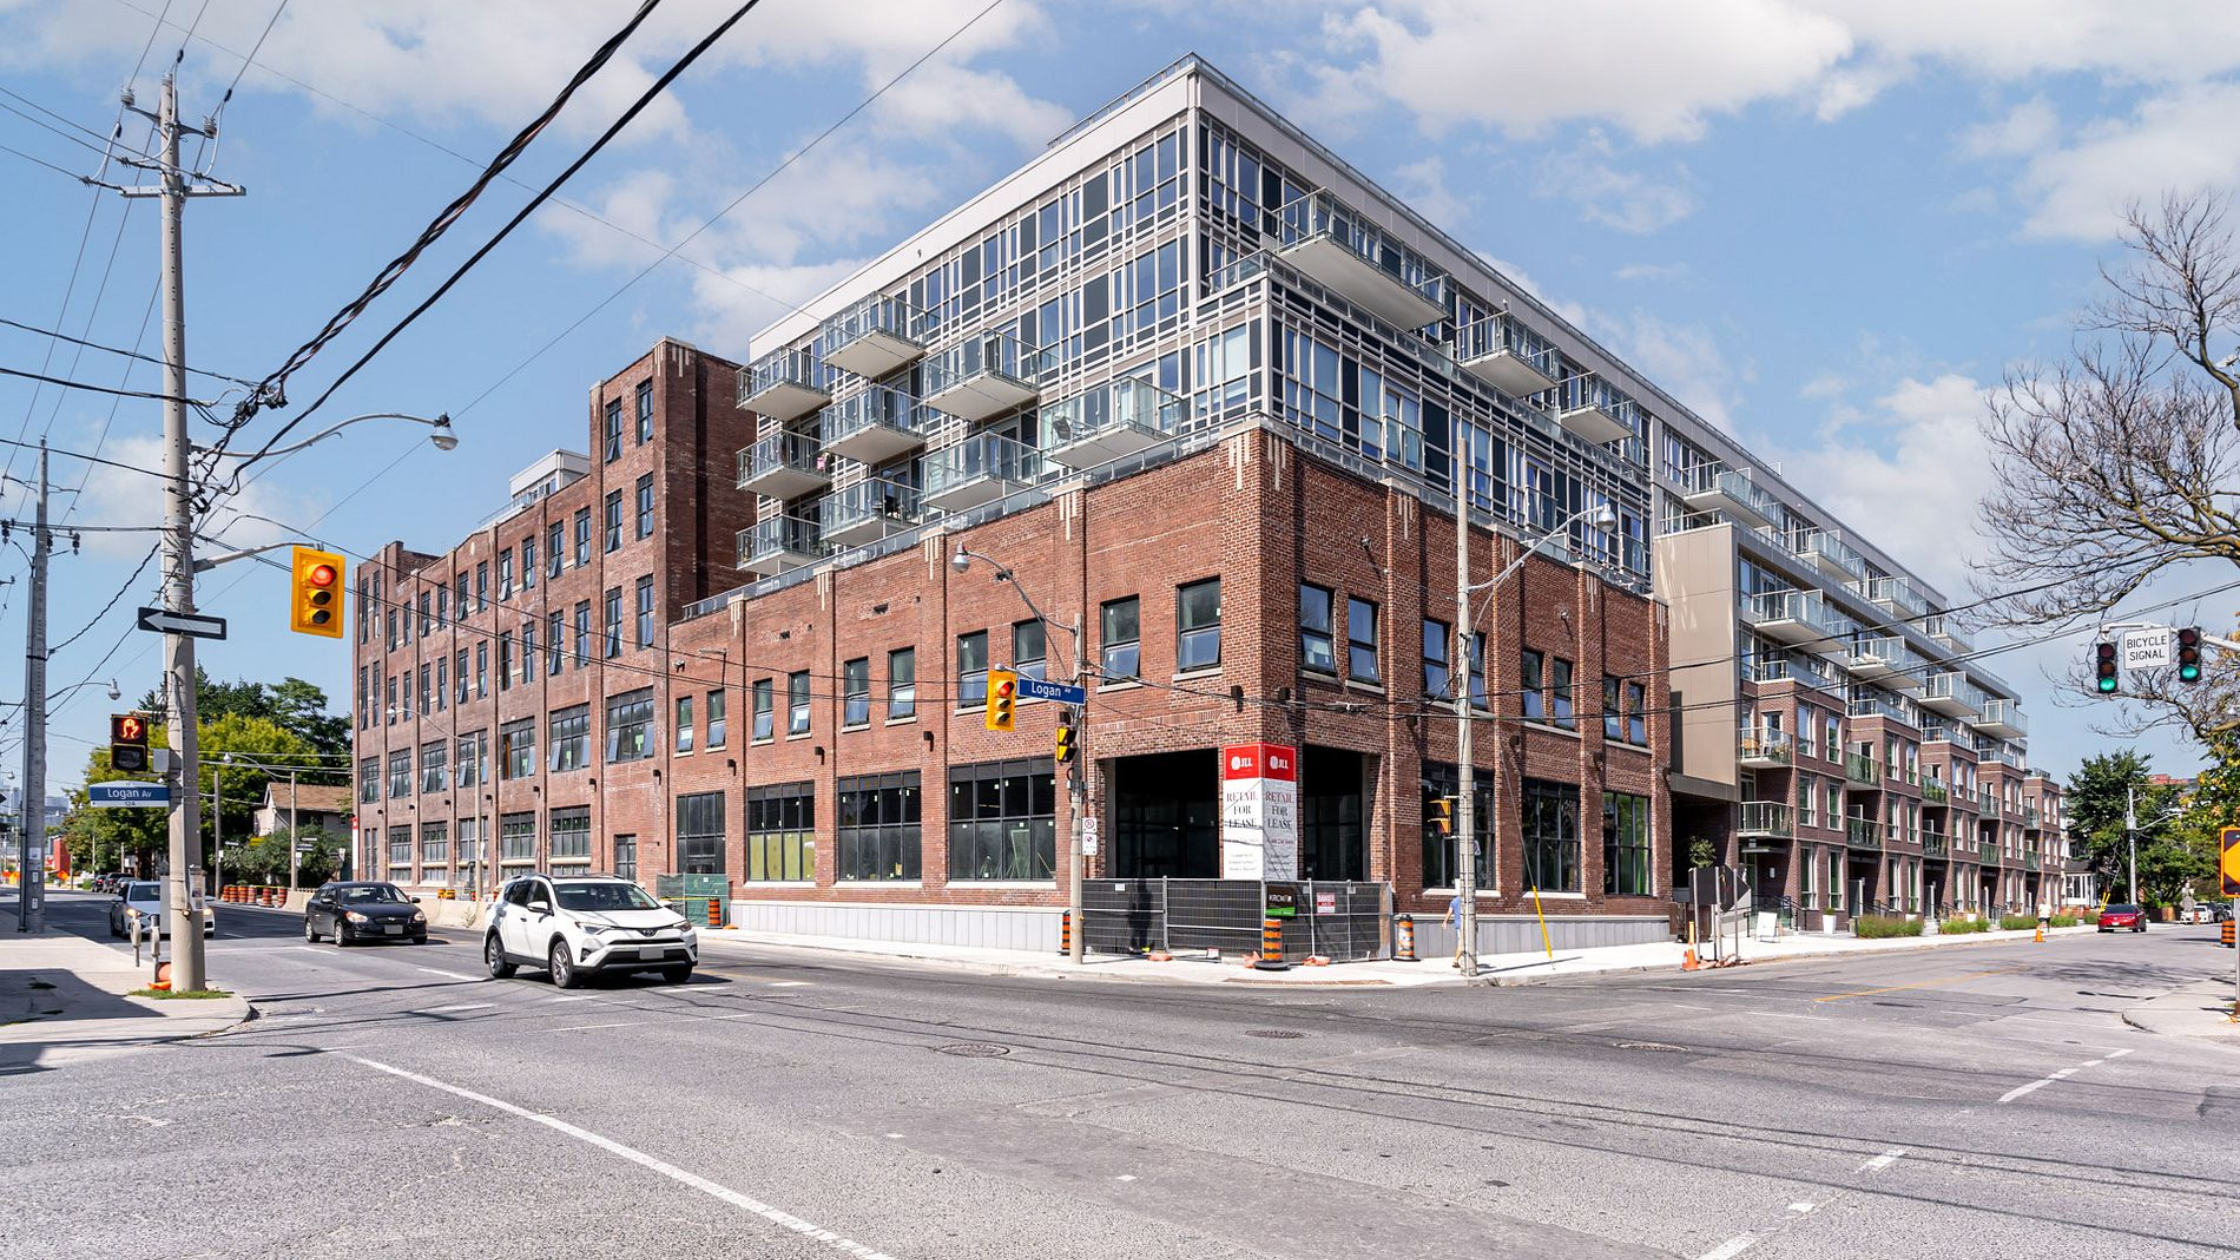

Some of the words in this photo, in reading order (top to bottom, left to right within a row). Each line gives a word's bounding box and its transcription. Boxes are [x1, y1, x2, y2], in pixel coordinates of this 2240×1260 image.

[2126, 635, 2167, 649] BICYCLE
[2129, 649, 2165, 661] SIGNAL
[1031, 681, 1061, 698] Logan
[107, 788, 139, 799] Logan
[1226, 791, 1259, 803] RETAIL
[1265, 791, 1292, 803] RETAIL
[1233, 805, 1251, 815] FOR
[1271, 804, 1288, 817] FOR
[1229, 818, 1257, 829] LEASE
[1267, 818, 1292, 830] LEASE
